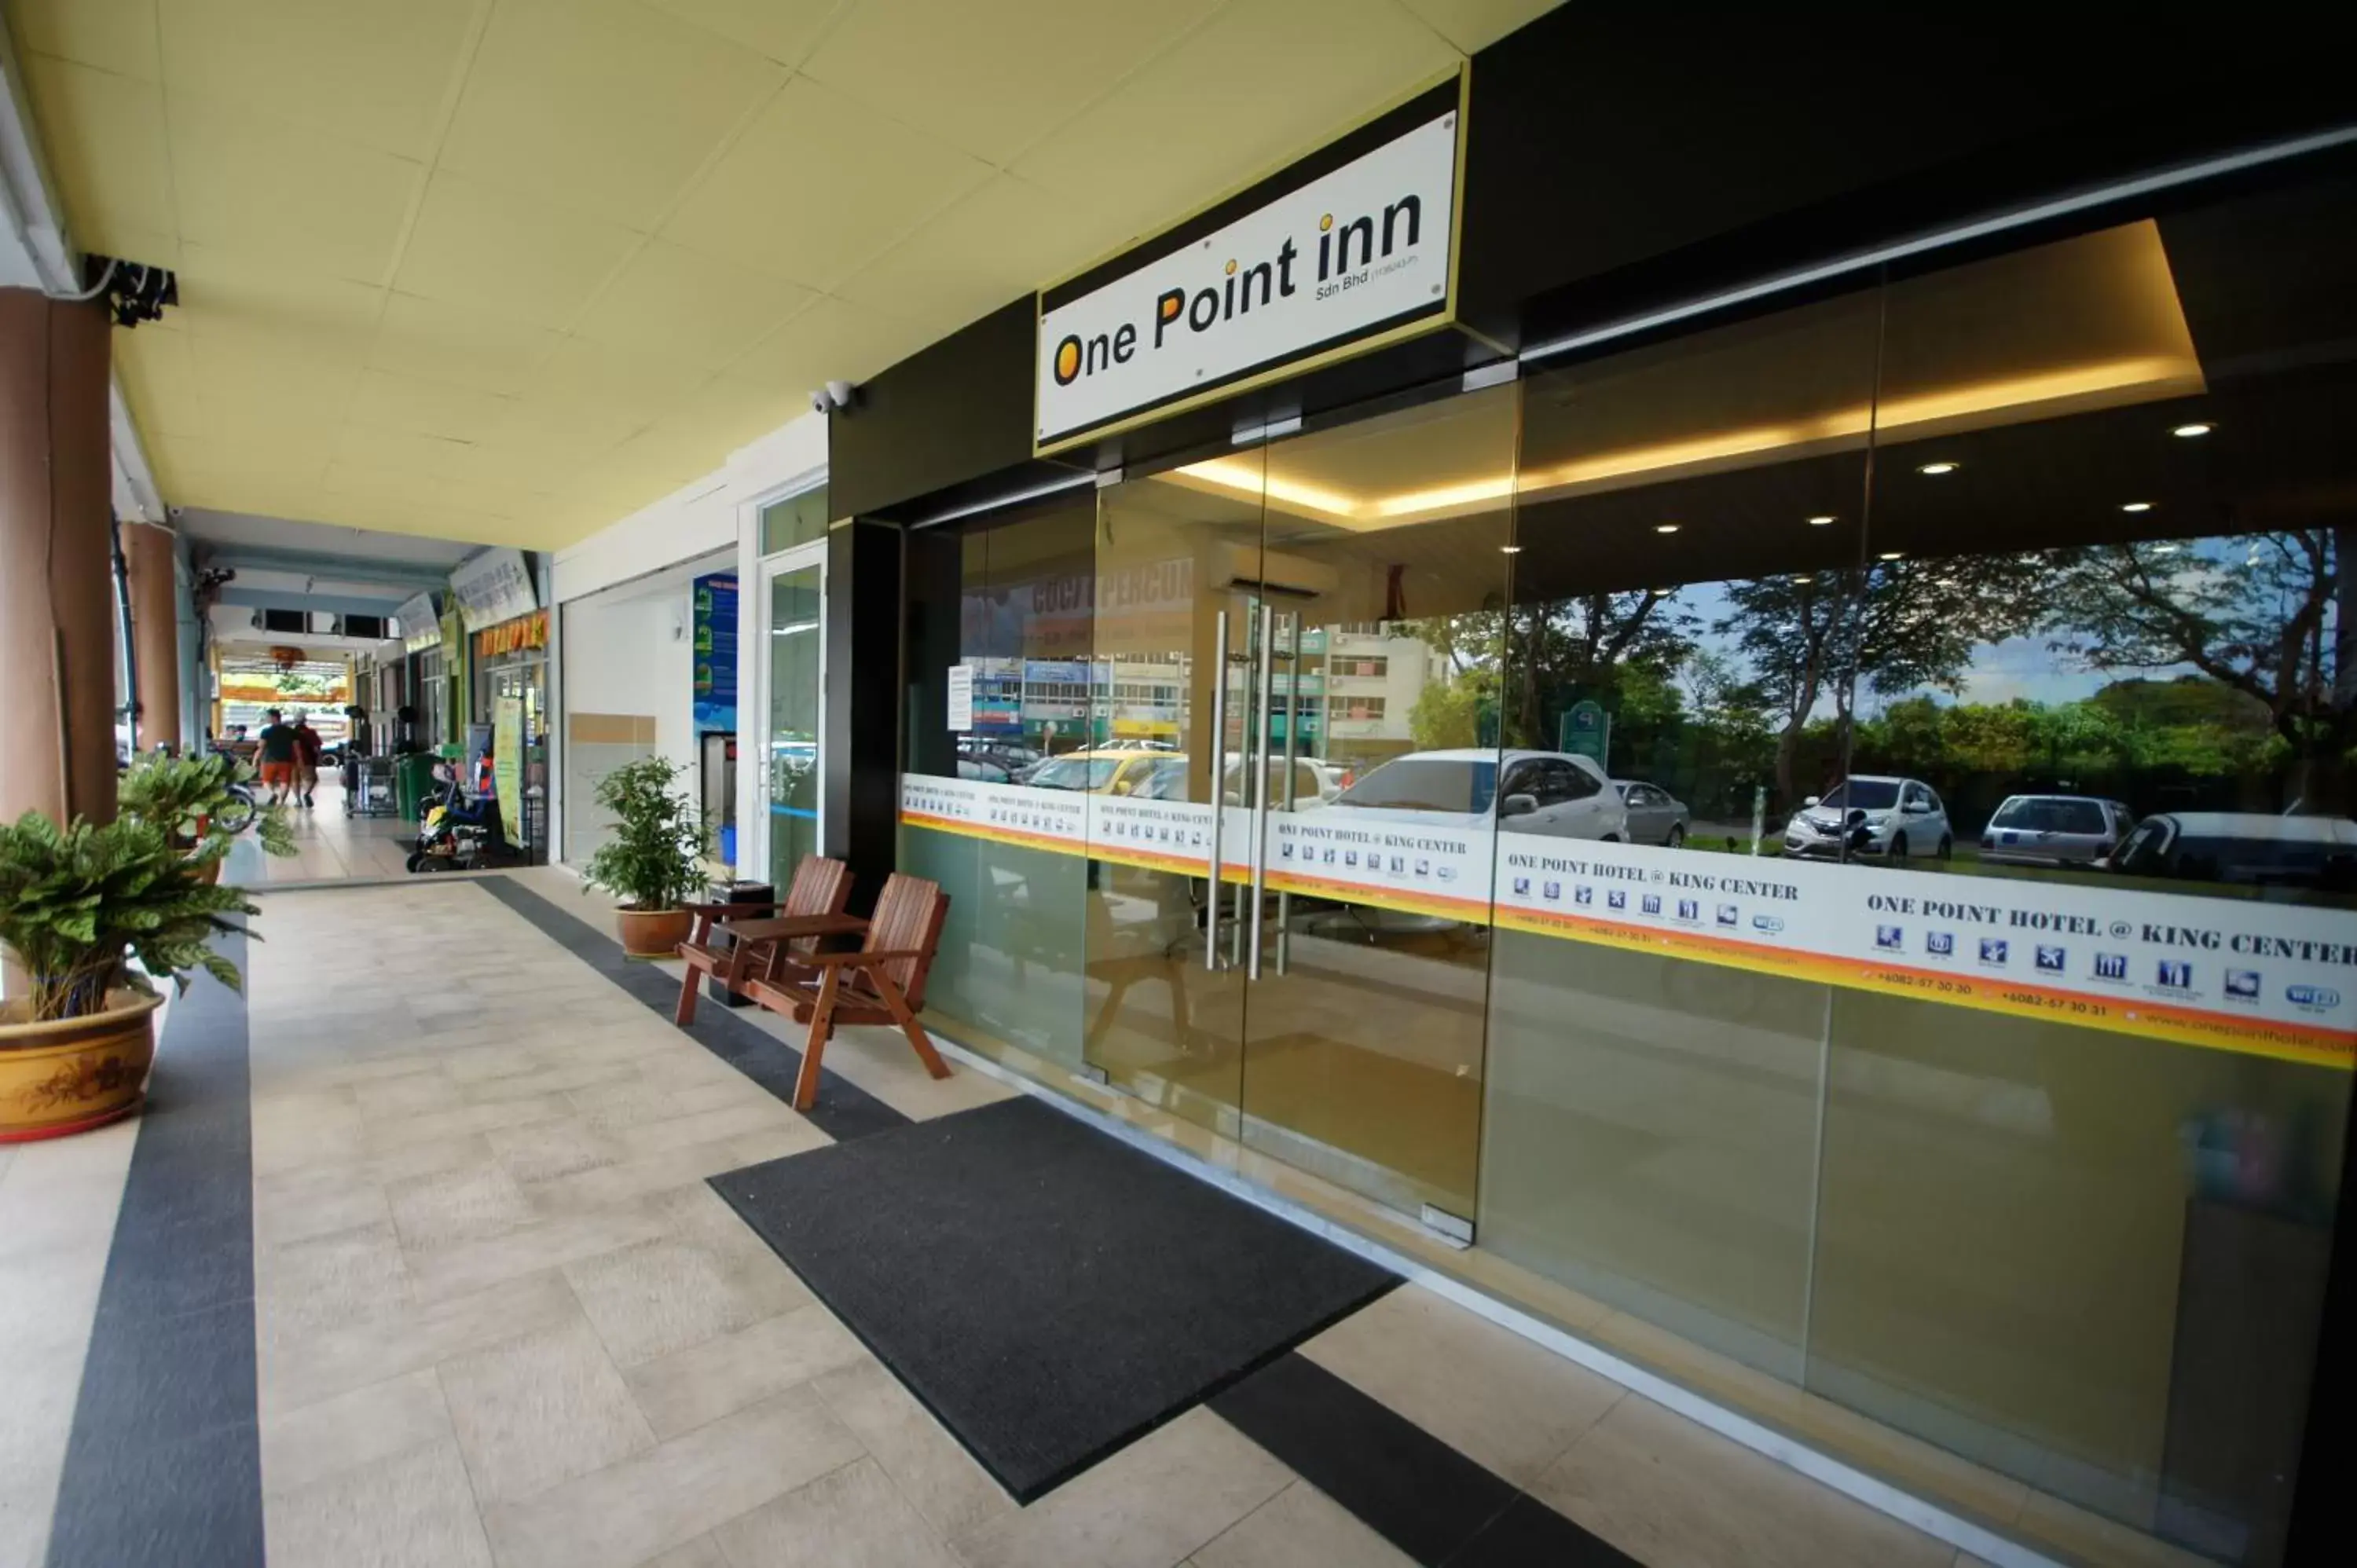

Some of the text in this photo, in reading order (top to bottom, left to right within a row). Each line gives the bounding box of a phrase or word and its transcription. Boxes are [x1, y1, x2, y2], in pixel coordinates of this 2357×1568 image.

[1054, 194, 1421, 386] One Point inn
[1315, 284, 1340, 300] Sdn
[1343, 269, 1368, 290] Bhd
[1278, 823, 1296, 835] ONE
[1300, 825, 1333, 840] POINT
[1335, 829, 1371, 844] HOTEL
[1385, 833, 1414, 849] KING
[1417, 837, 1467, 855] CENTER
[1508, 853, 1538, 868] ONE
[1541, 857, 1589, 874] POINT
[1593, 863, 1648, 882] HOTEL
[1669, 871, 1716, 891] KING
[1721, 877, 1798, 900] CENTER
[1867, 893, 1916, 914] ONE
[1923, 900, 2001, 924] POINT
[2010, 909, 2102, 937] HOTEL
[2110, 920, 2132, 940] @
[2142, 923, 2221, 951] KING
